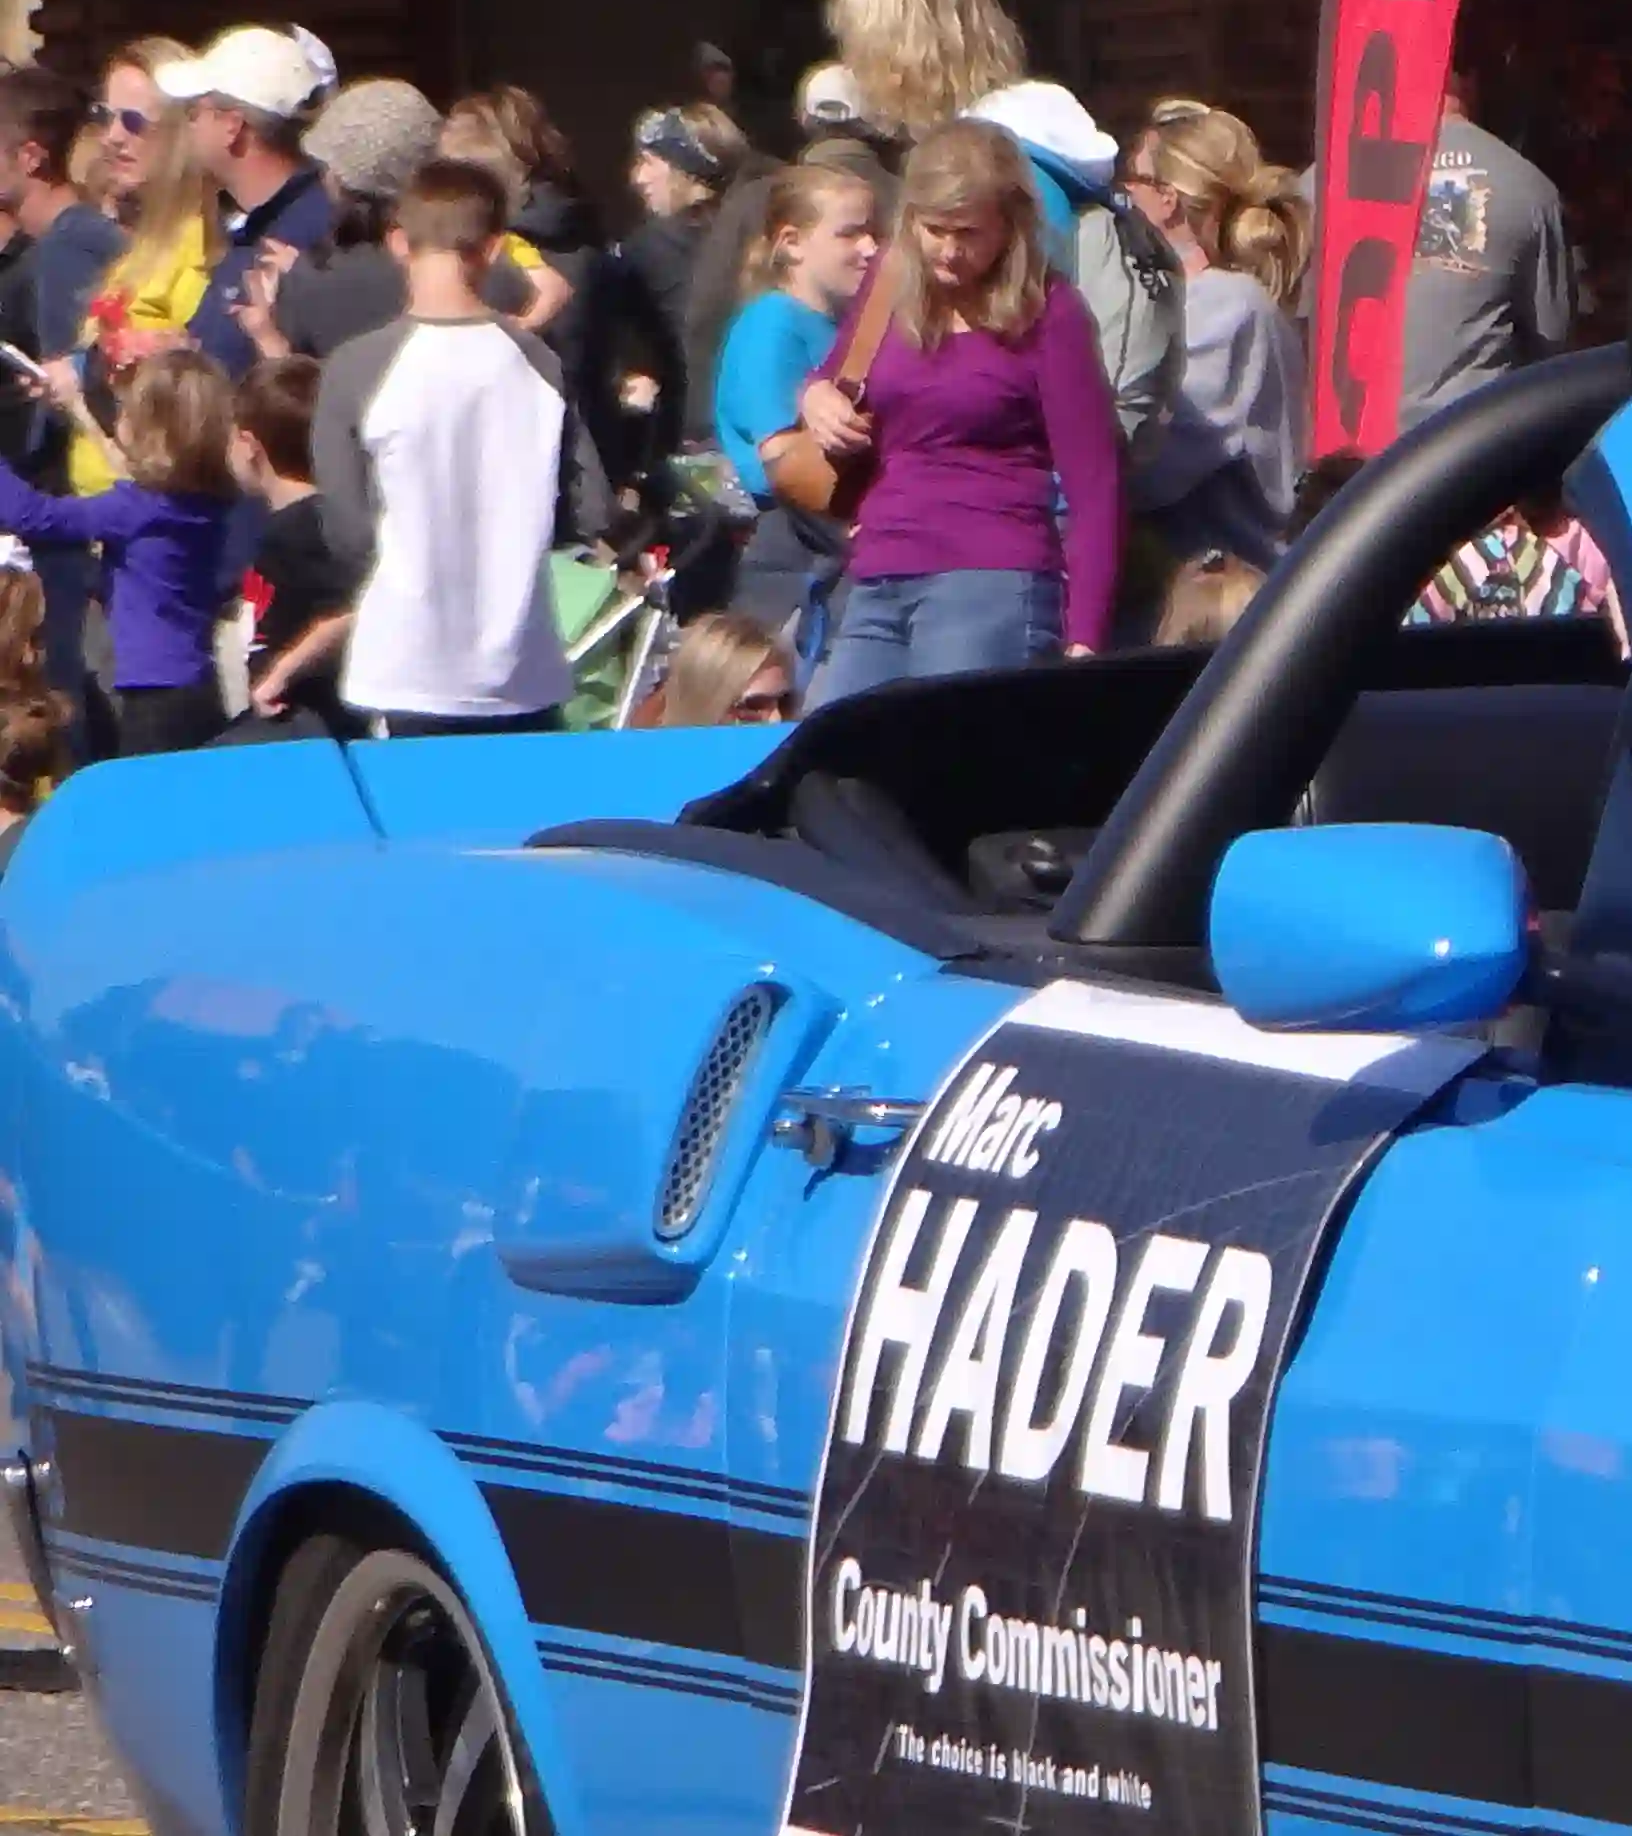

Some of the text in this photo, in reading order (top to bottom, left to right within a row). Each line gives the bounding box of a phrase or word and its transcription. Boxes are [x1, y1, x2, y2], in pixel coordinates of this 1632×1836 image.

[922, 1060, 1063, 1182] Marc
[840, 1188, 1275, 1524] HADER
[834, 1557, 1222, 1731] County Commissioner
[897, 1722, 1152, 1811] The choice is black and white
